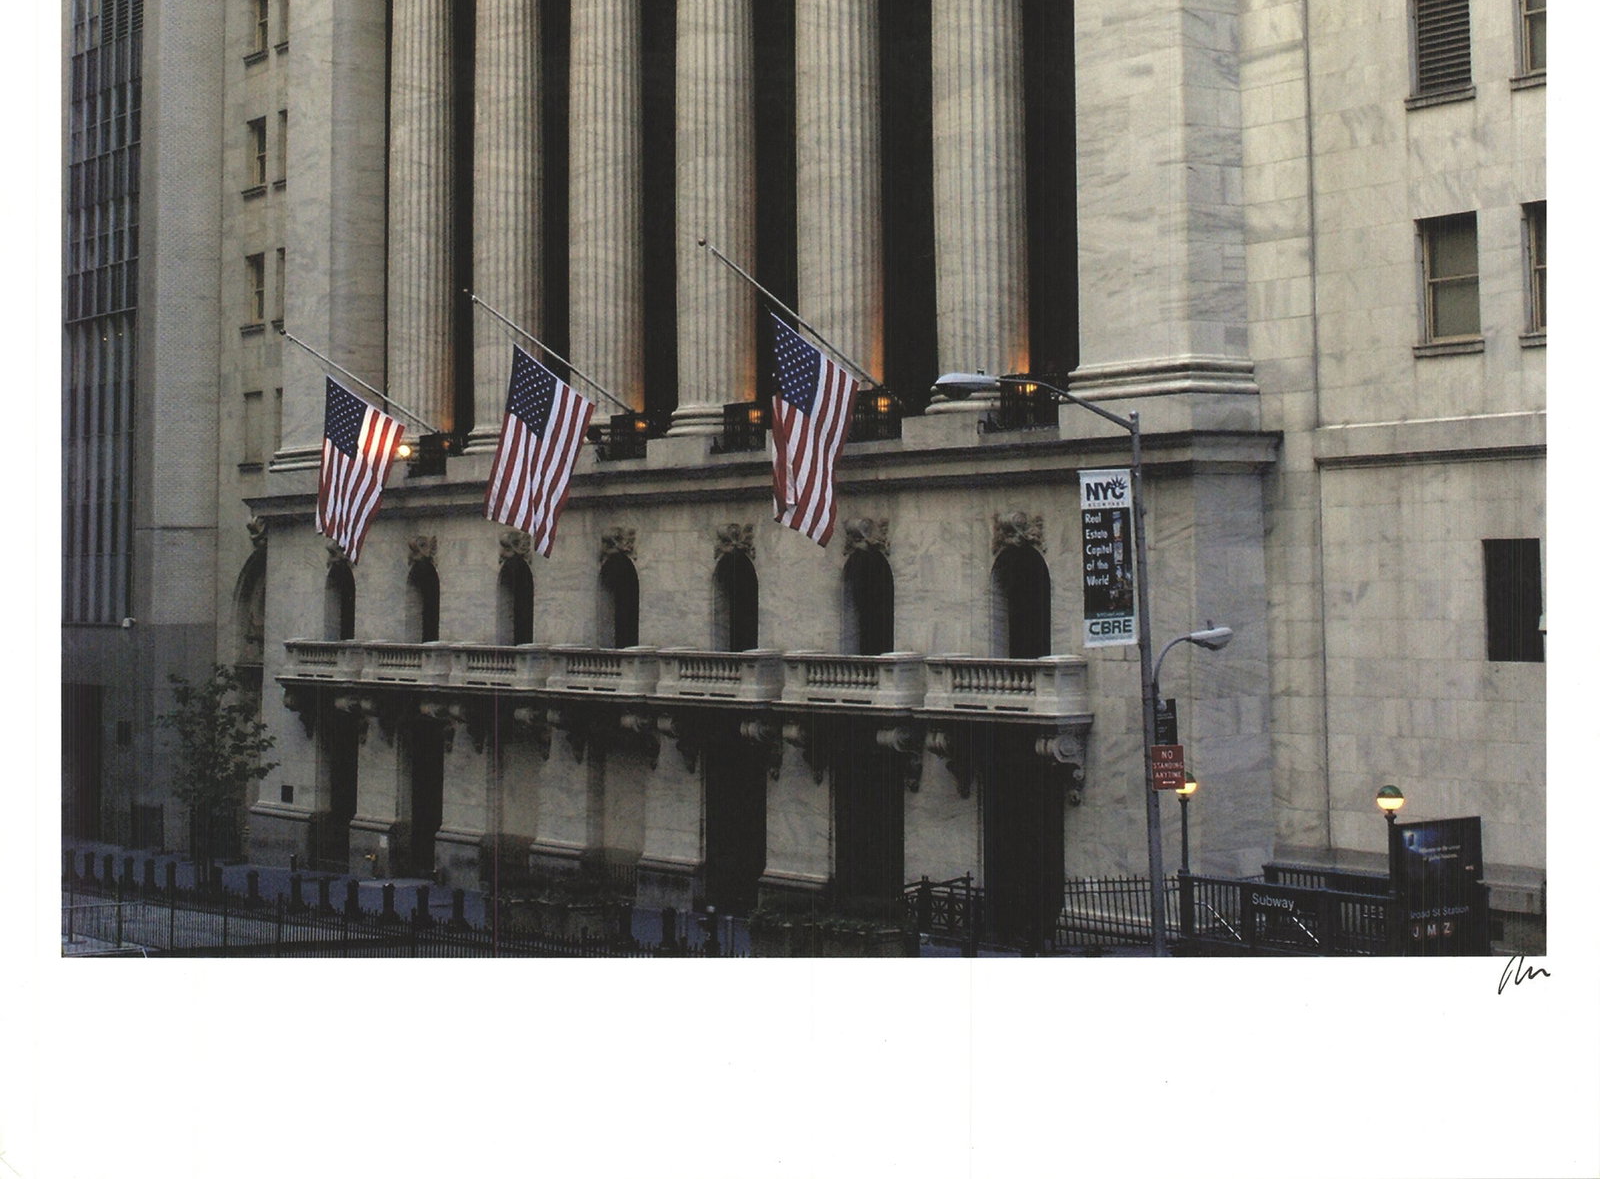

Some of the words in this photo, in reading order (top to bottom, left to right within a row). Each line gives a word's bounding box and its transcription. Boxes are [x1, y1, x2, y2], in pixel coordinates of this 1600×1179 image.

[1085, 476, 1127, 501] NYC
[1085, 512, 1102, 524] Real
[1085, 528, 1109, 540] Estate
[1086, 542, 1113, 557] Capital
[1086, 559, 1095, 571] of
[1097, 559, 1109, 570] the
[1086, 574, 1110, 586] World
[1088, 619, 1133, 636] CBRE
[1161, 750, 1174, 759] NO
[1153, 762, 1184, 770] STANDING
[1155, 771, 1182, 779] ANYTIME
[1252, 892, 1295, 911] Subway
